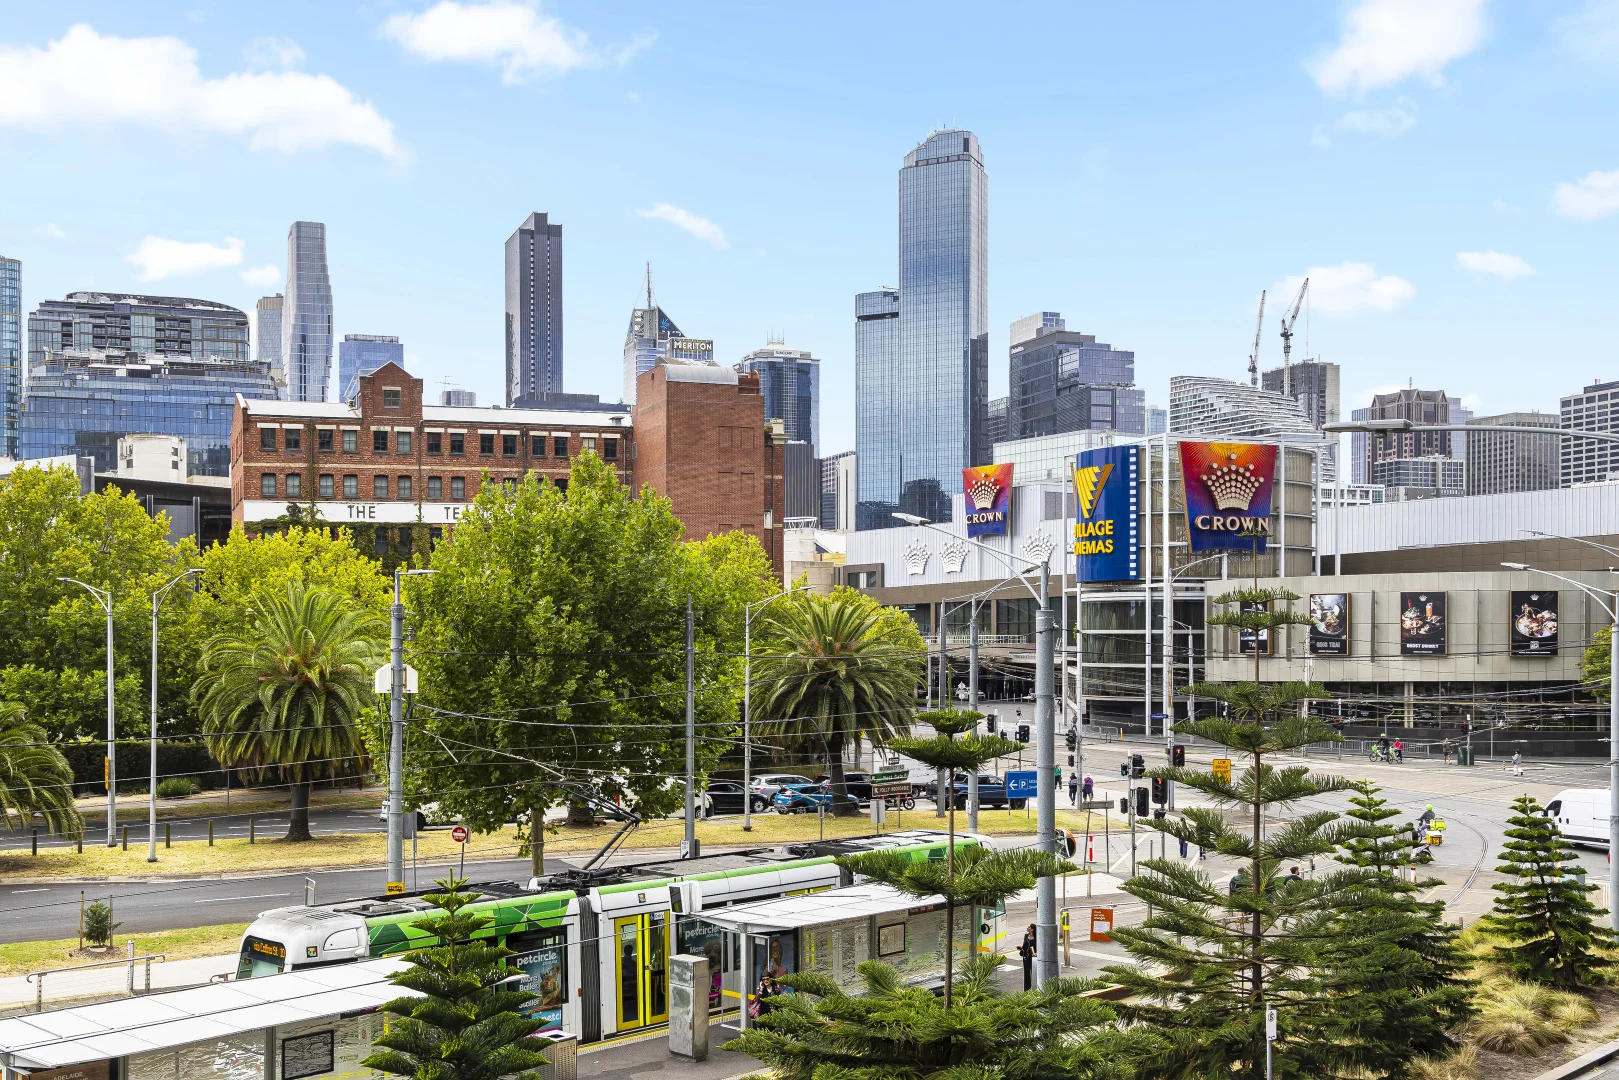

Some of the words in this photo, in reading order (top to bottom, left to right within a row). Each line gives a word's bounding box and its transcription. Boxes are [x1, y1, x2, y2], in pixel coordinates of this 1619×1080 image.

[674, 341, 712, 350] MERITON
[347, 505, 376, 519] THE
[444, 507, 462, 519] TE
[965, 512, 1003, 524] CROWN
[1195, 515, 1269, 531] CROWN
[685, 925, 719, 940] petcircle
[517, 951, 557, 968] petcircle
[520, 975, 538, 983] More
[53, 1072, 83, 1080] ADELAIDE
